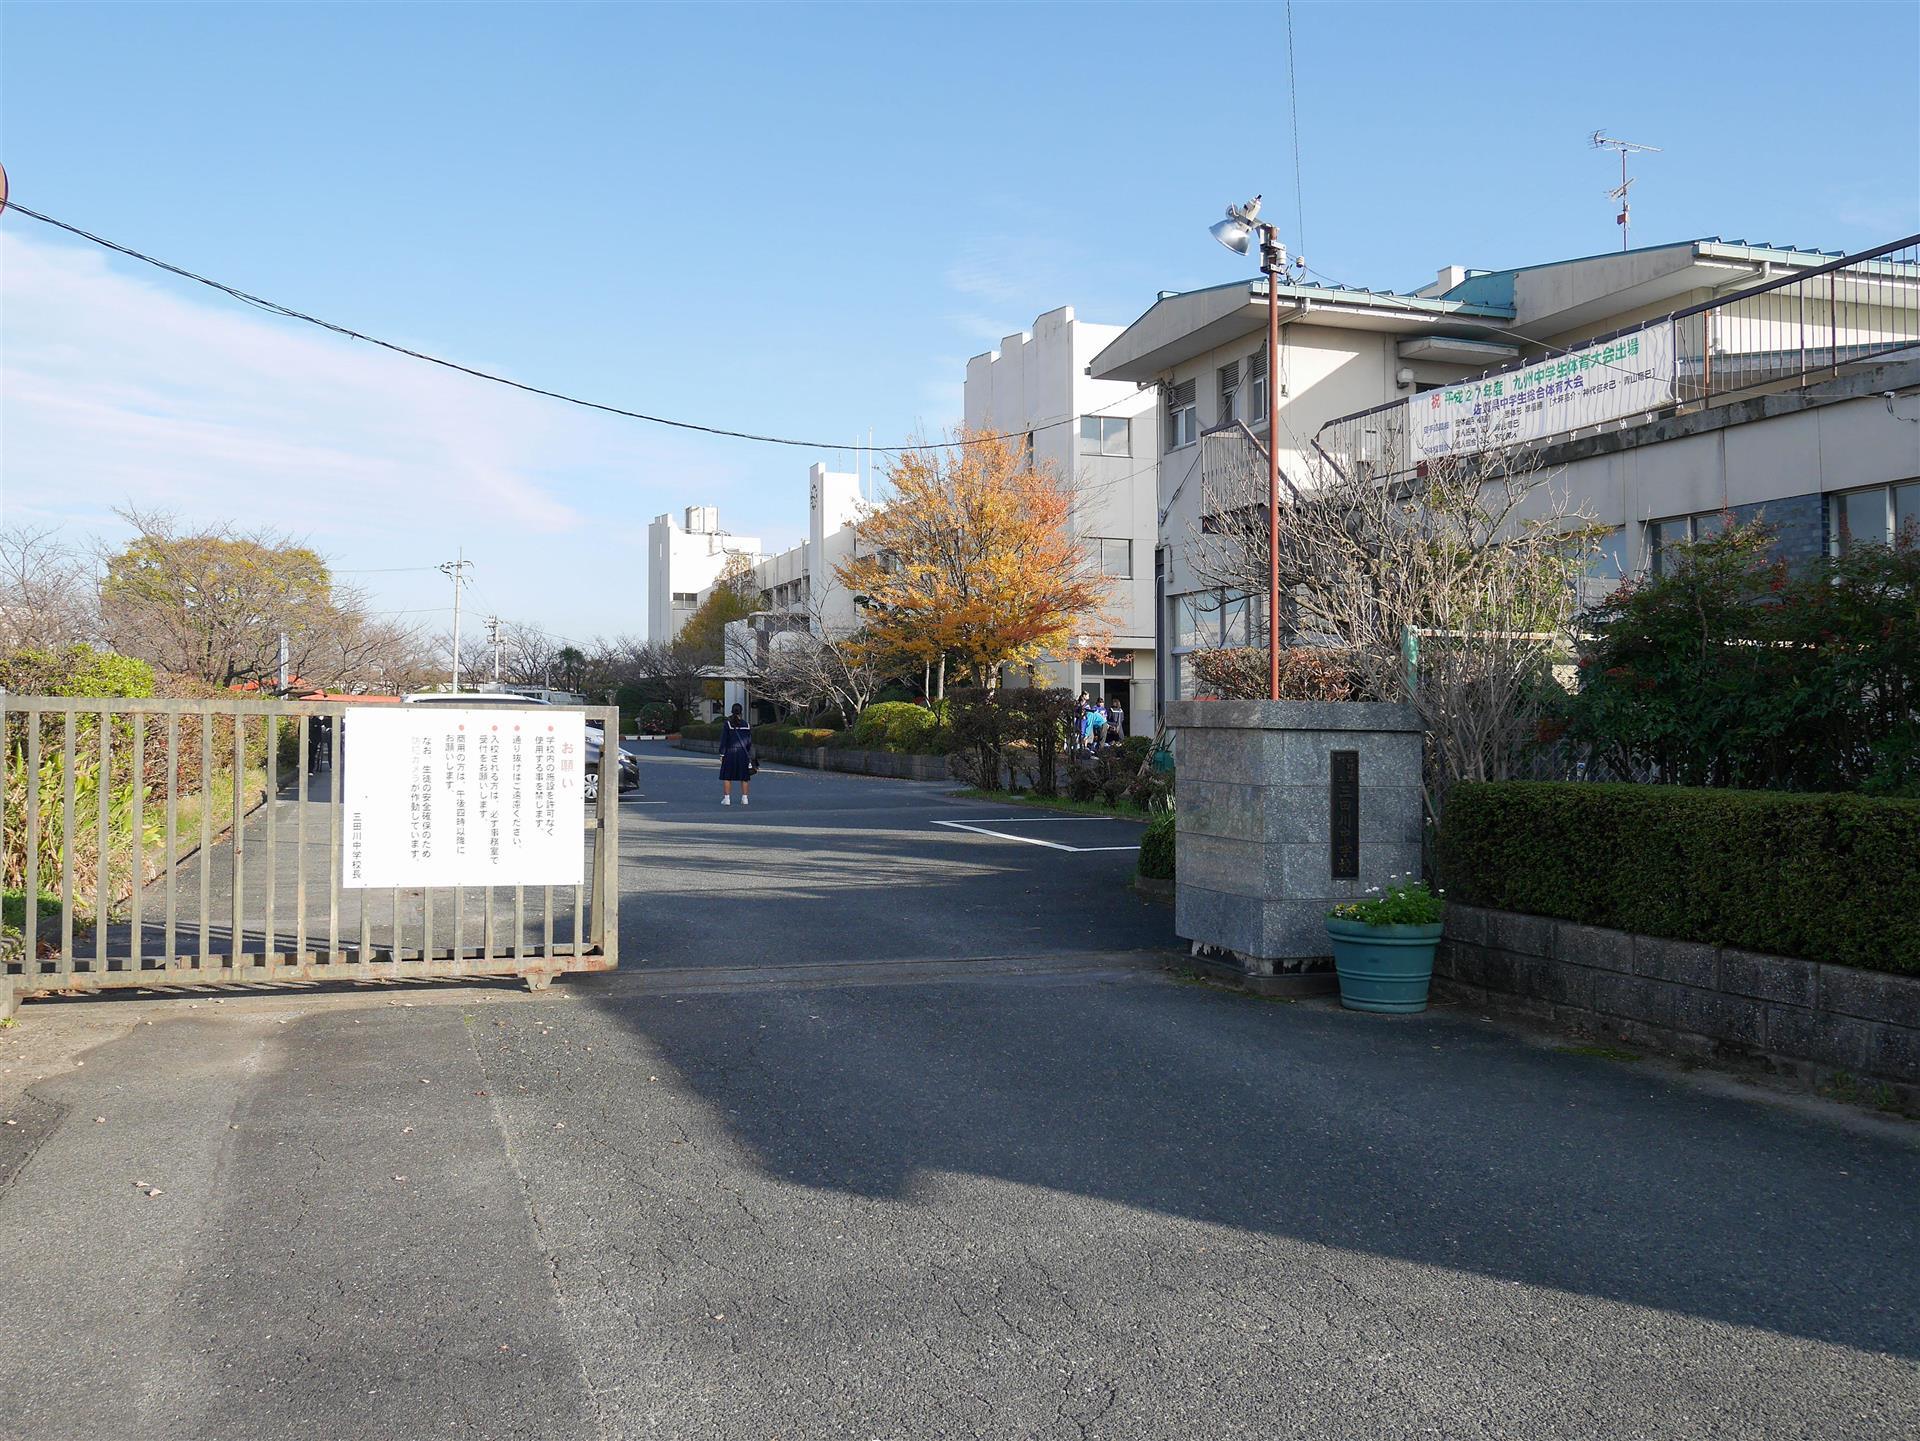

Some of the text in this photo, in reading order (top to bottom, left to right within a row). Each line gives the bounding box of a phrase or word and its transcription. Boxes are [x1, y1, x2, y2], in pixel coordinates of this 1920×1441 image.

[1431, 393, 1439, 409] 祝
[1512, 337, 1639, 390] 九州中学生体育大会出場
[1473, 373, 1583, 416] 佐賀県中学生総合体育大会
[445, 733, 455, 793] お願いします。
[478, 734, 489, 822] 受付をお願いします。
[560, 741, 574, 788] お願い
[422, 736, 432, 858] なお、生徒の安全確保のため
[352, 812, 362, 879] 三田川中学校長
